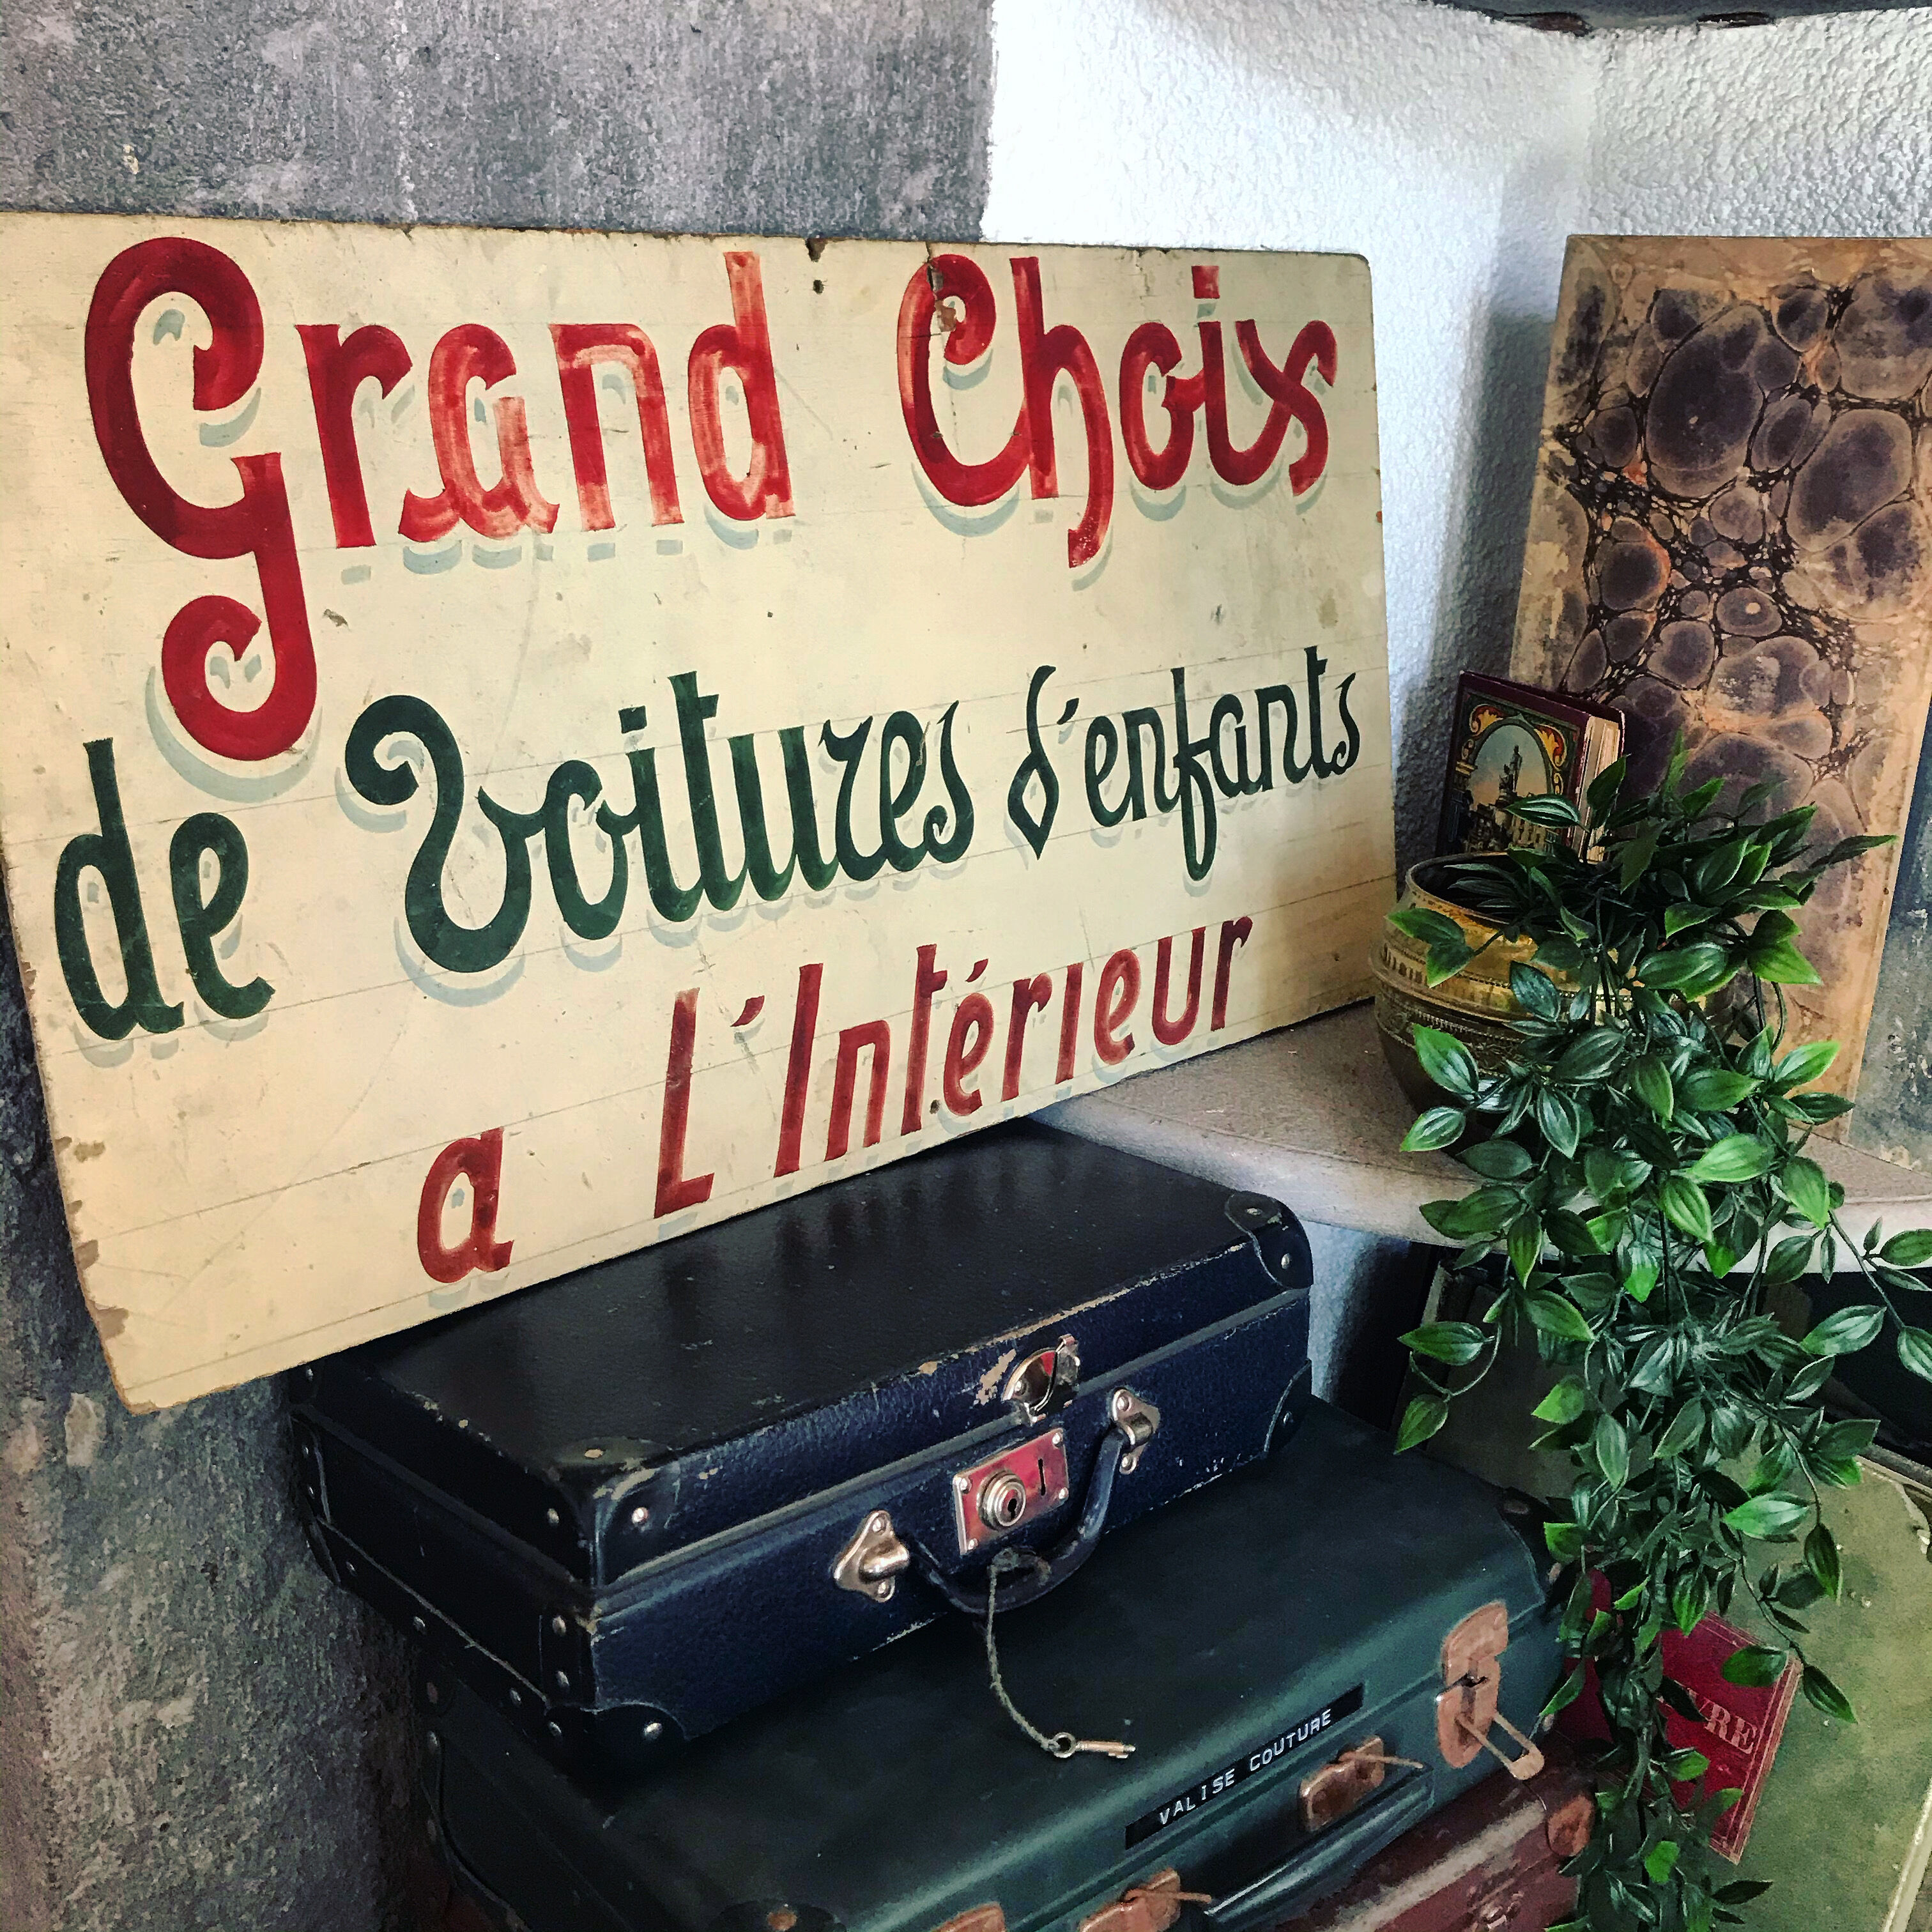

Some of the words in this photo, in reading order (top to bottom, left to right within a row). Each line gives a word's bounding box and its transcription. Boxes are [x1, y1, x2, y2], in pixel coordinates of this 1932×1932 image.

[84, 236, 796, 762] Grand
[897, 254, 1338, 569] Choix
[54, 736, 276, 1041] de
[345, 670, 974, 973] Voitures
[1007, 645, 1361, 882] d'enfants
[417, 1126, 515, 1284] a
[1158, 1768, 1236, 1825] VALISE
[1249, 1708, 1332, 1772] COUTURE
